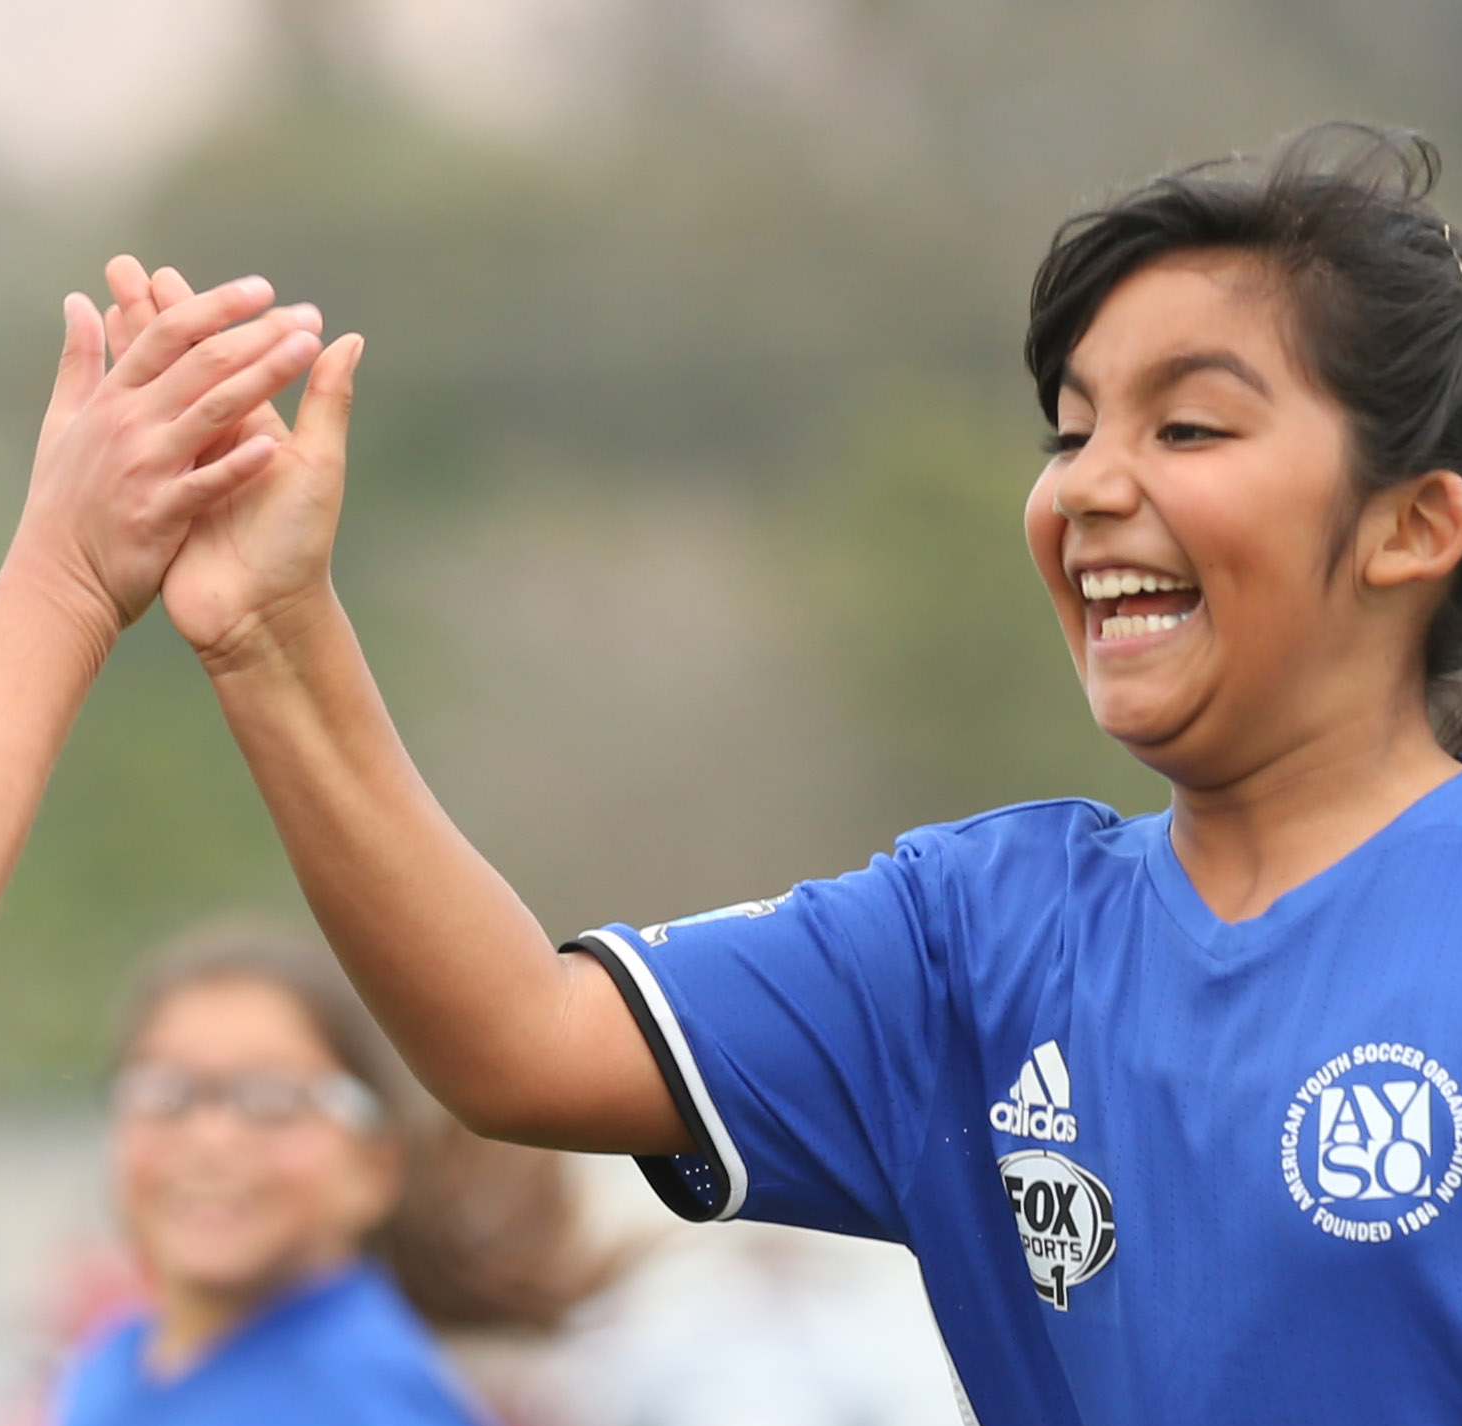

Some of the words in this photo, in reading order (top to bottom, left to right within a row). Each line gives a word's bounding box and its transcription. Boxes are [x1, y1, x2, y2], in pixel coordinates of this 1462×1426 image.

[1296, 1052, 1352, 1104] YOUTH
[1352, 1042, 1425, 1071] SOCCER
[989, 1100, 1077, 1143] adidas
[1281, 1102, 1315, 1211] AMERICAN
[1004, 1175, 1081, 1238] FOX
[1312, 1206, 1392, 1242] FOUNDED
[1022, 1234, 1083, 1262] PORTS
[1051, 1264, 1066, 1308] 1
